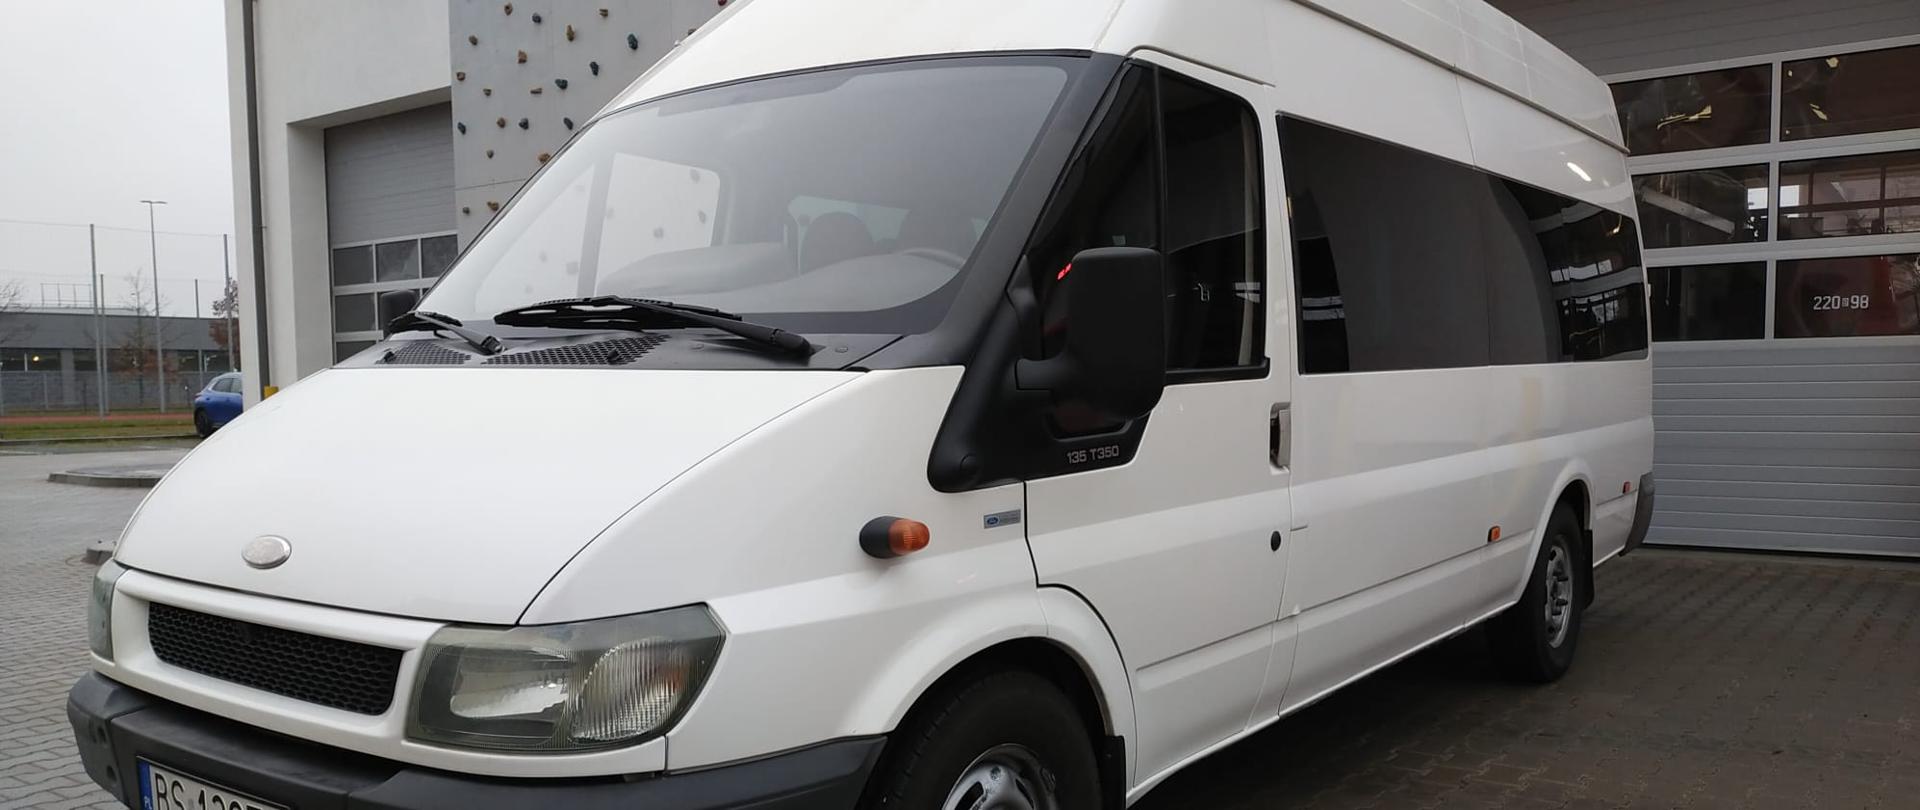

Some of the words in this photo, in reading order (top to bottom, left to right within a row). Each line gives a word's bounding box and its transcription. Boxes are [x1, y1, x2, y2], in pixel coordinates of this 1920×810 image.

[1067, 450, 1088, 464] 135
[1089, 444, 1120, 461] T350
[154, 772, 185, 810] BS
